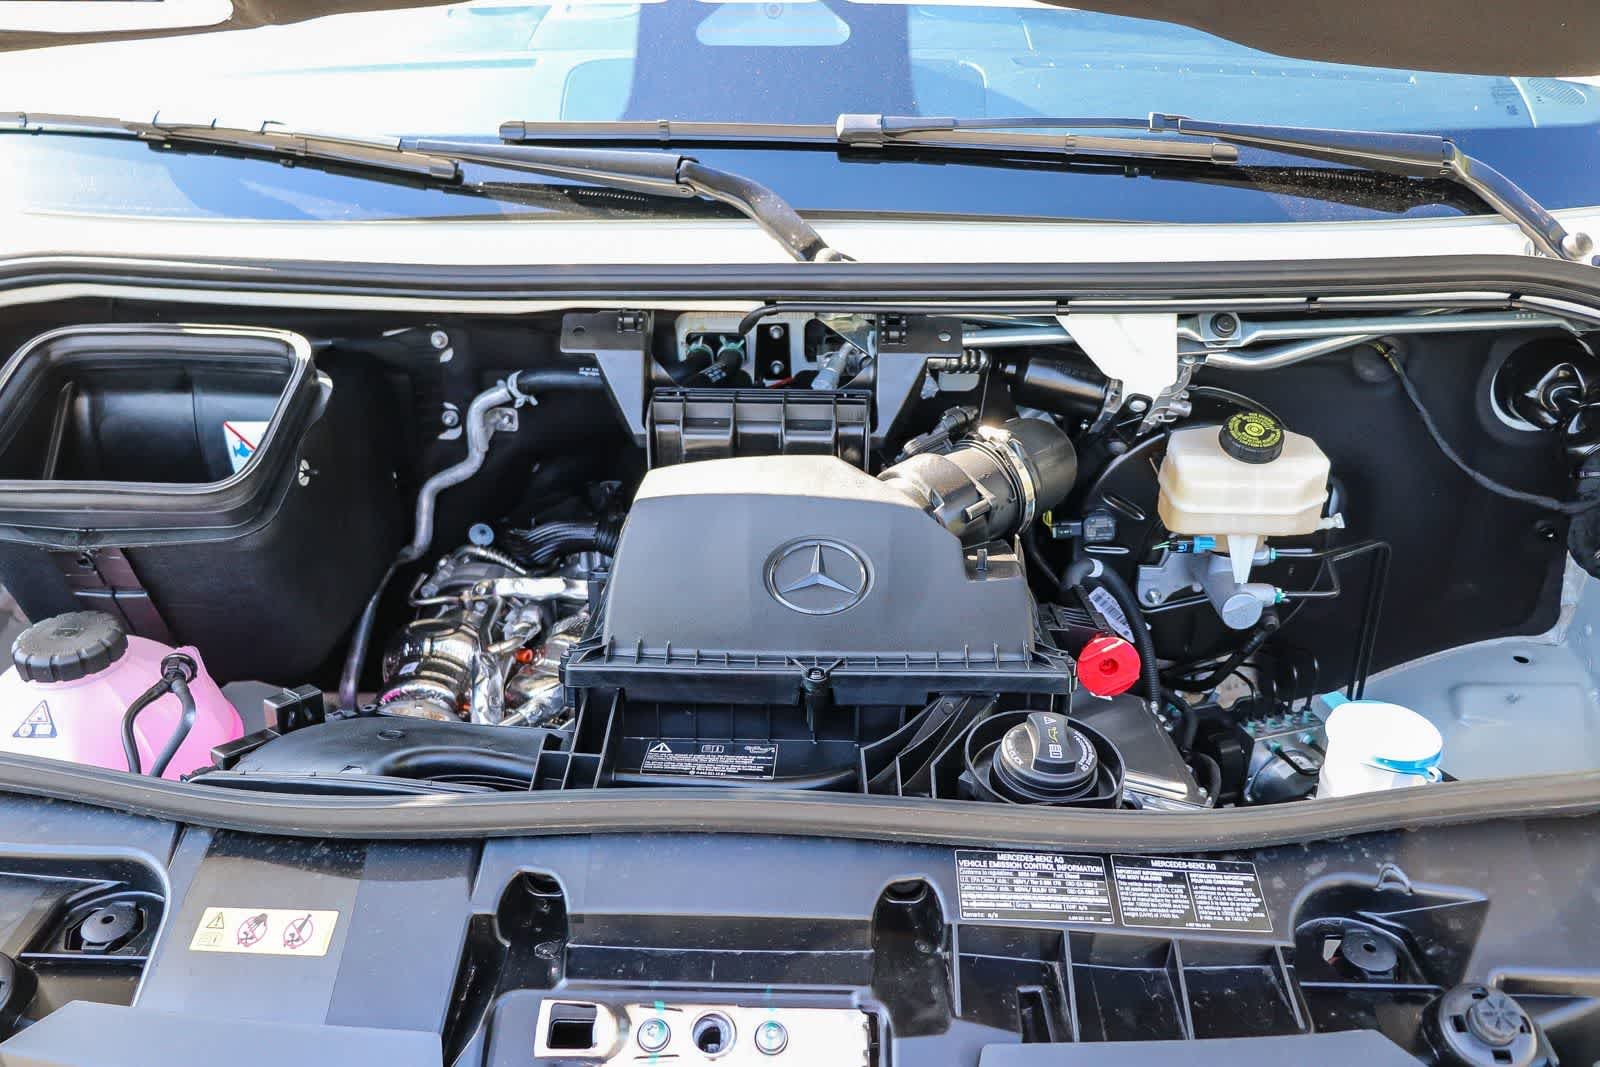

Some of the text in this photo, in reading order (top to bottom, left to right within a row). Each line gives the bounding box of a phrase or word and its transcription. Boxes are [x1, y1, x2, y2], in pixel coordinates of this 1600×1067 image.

[996, 853, 1052, 862] MERCEDES-BENZ
[1056, 863, 1103, 872] INFORMATION
[1150, 859, 1206, 869] MERCEDES-BENZ
